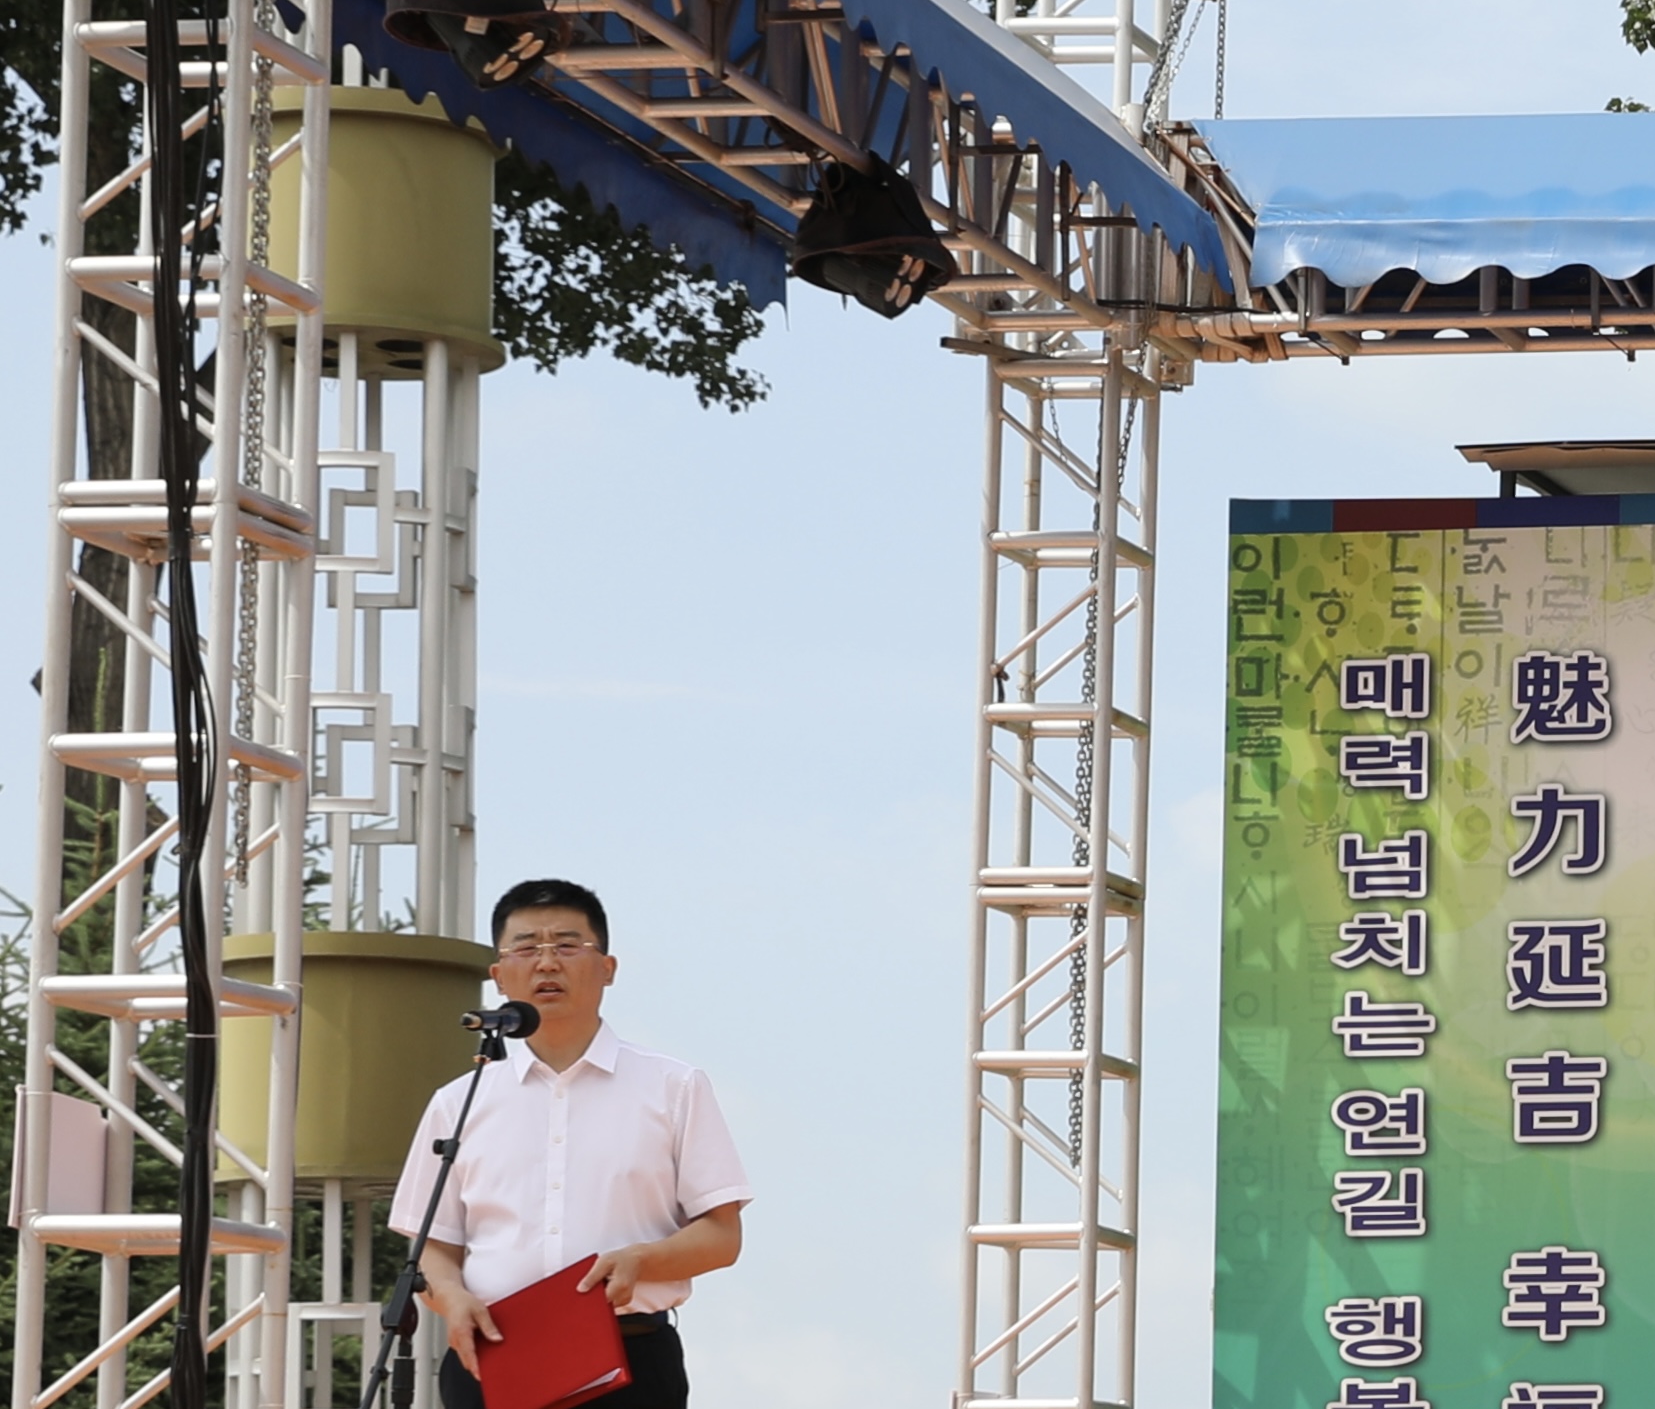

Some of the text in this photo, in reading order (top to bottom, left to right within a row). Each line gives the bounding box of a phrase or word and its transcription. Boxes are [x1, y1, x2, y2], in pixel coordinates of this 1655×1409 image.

[1339, 652, 1431, 801] 매력
[1331, 830, 1437, 1058] 넘치는
[1507, 649, 1612, 1144] 魅力延吉
[1331, 1087, 1427, 1237] 연길
